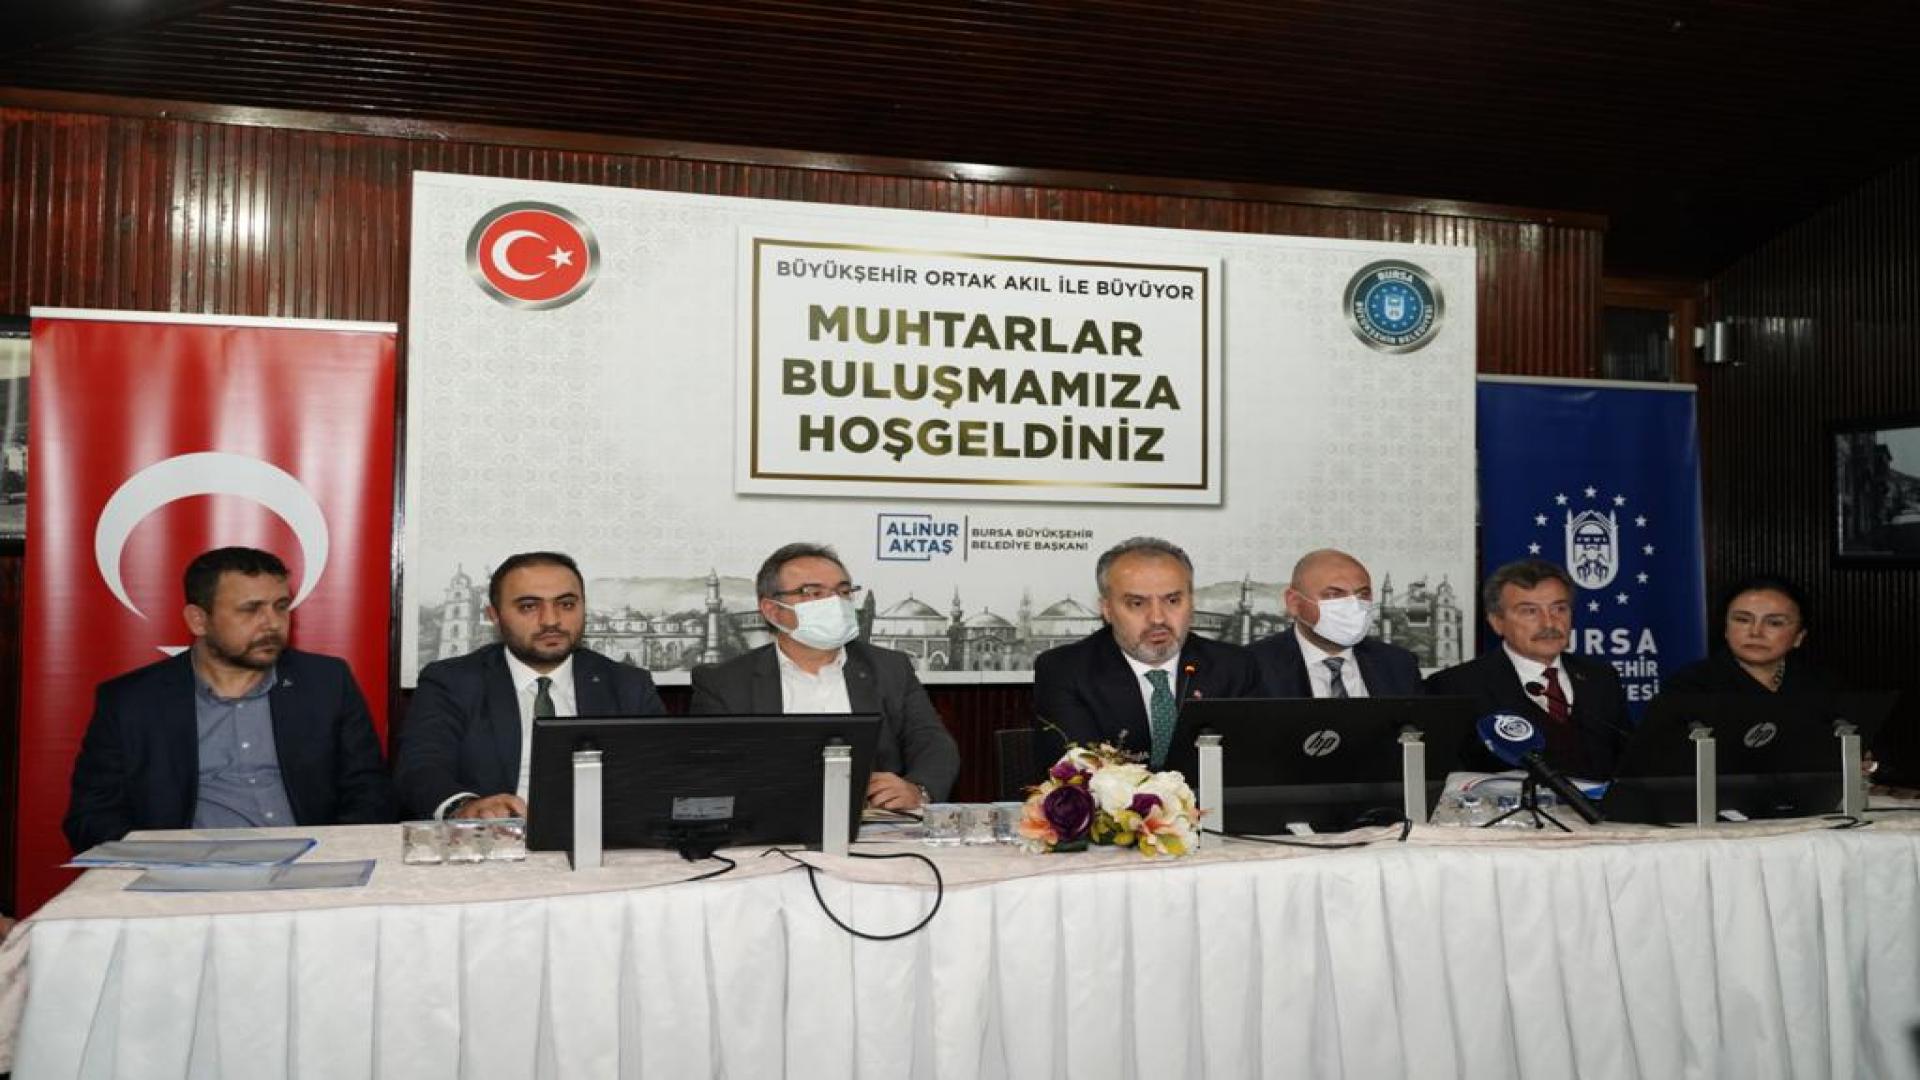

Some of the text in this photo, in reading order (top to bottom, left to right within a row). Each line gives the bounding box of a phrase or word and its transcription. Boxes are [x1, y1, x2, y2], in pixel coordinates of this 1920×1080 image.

[777, 259, 1194, 300] BÜYÜKŞEHİR ORTAK AKIL İLE BÜYÜYOR
[808, 304, 1143, 356] MUHTARLAR
[782, 357, 1181, 410] BULUŞMAMIZA
[799, 414, 1165, 462] HOŞGELDİNİZ
[888, 539, 953, 555] AKTAŞ
[971, 527, 1094, 540] BURSA BÜYÜKŞEHİR
[971, 540, 1089, 552] BELEDİYE BAŞKANI
